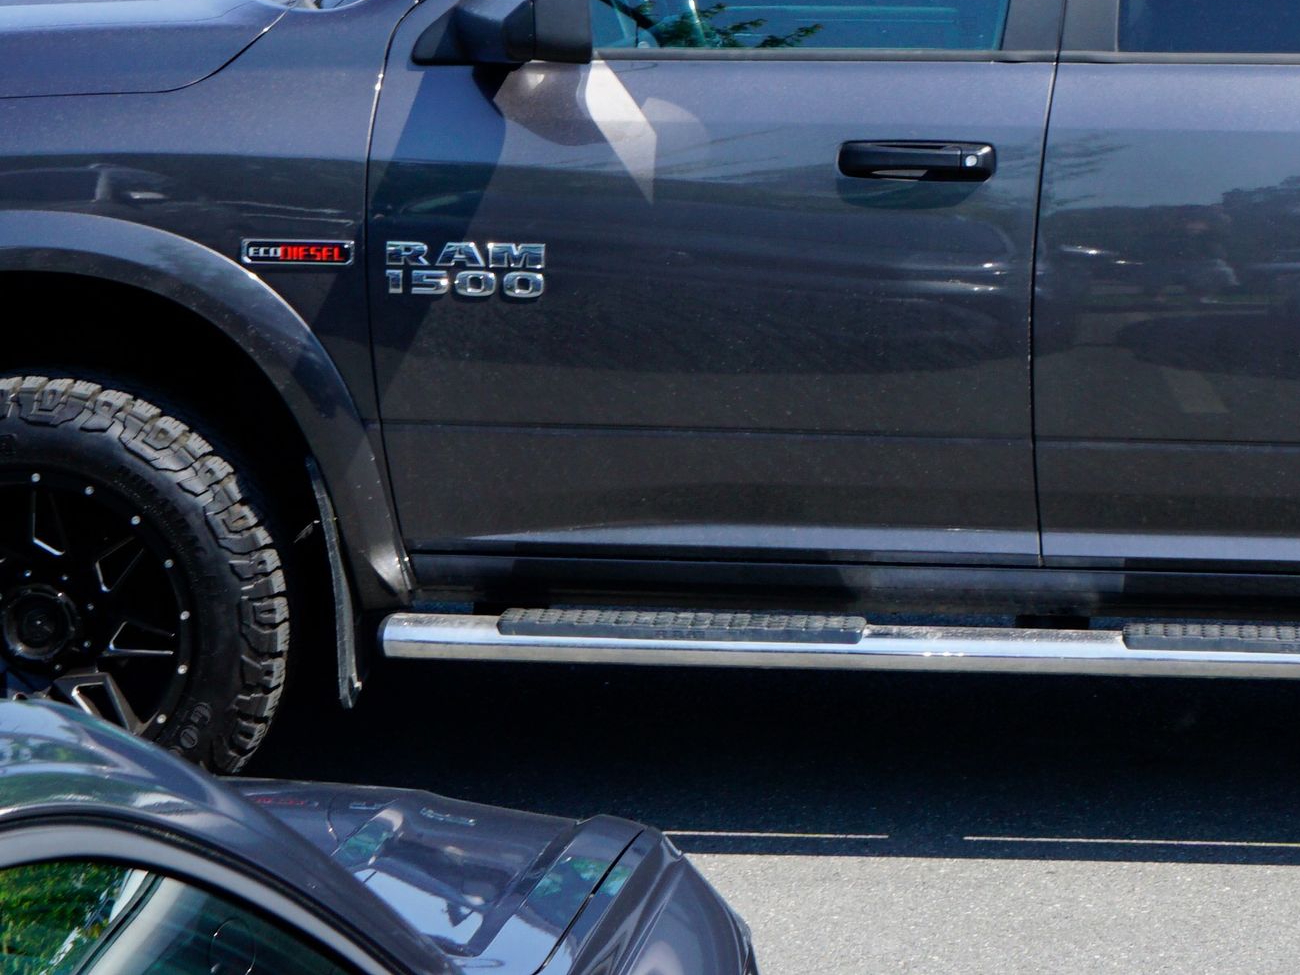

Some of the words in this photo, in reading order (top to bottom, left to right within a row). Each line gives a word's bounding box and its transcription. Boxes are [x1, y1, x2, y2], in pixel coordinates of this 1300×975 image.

[248, 245, 345, 261] ECODIESEL
[385, 241, 546, 268] RAM
[385, 270, 545, 298] 1500
